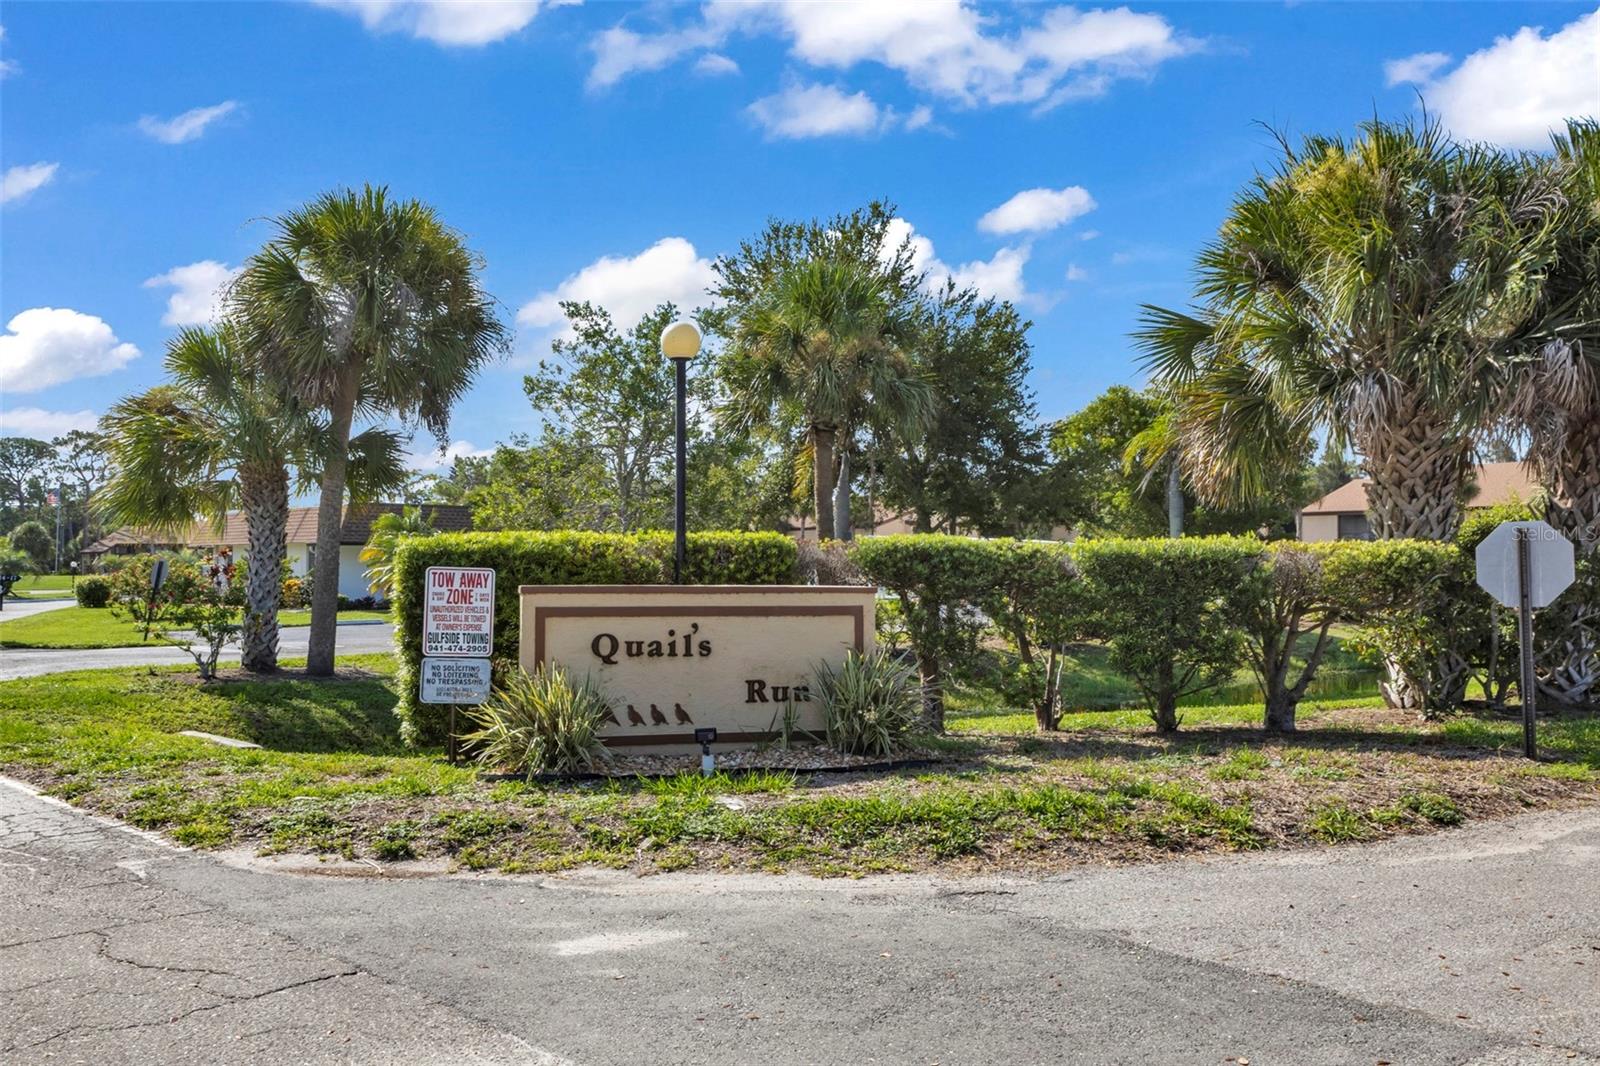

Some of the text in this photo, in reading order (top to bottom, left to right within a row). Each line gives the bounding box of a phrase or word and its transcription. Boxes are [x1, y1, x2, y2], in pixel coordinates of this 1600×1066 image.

[431, 571, 490, 589] TOW AWAY
[446, 588, 474, 605] ZONE
[430, 605, 464, 613] UNAUTHORIZED
[464, 606, 485, 614] VEHICLES
[432, 614, 452, 622] VESSELS
[452, 614, 463, 622] WILL
[470, 615, 487, 623] TOWED
[427, 632, 489, 644] GULFSIDE TOWING
[591, 622, 712, 665] Quail's
[442, 664, 481, 672] SOLICITING
[438, 678, 483, 686] TRESPASSING
[745, 679, 811, 703] Run
